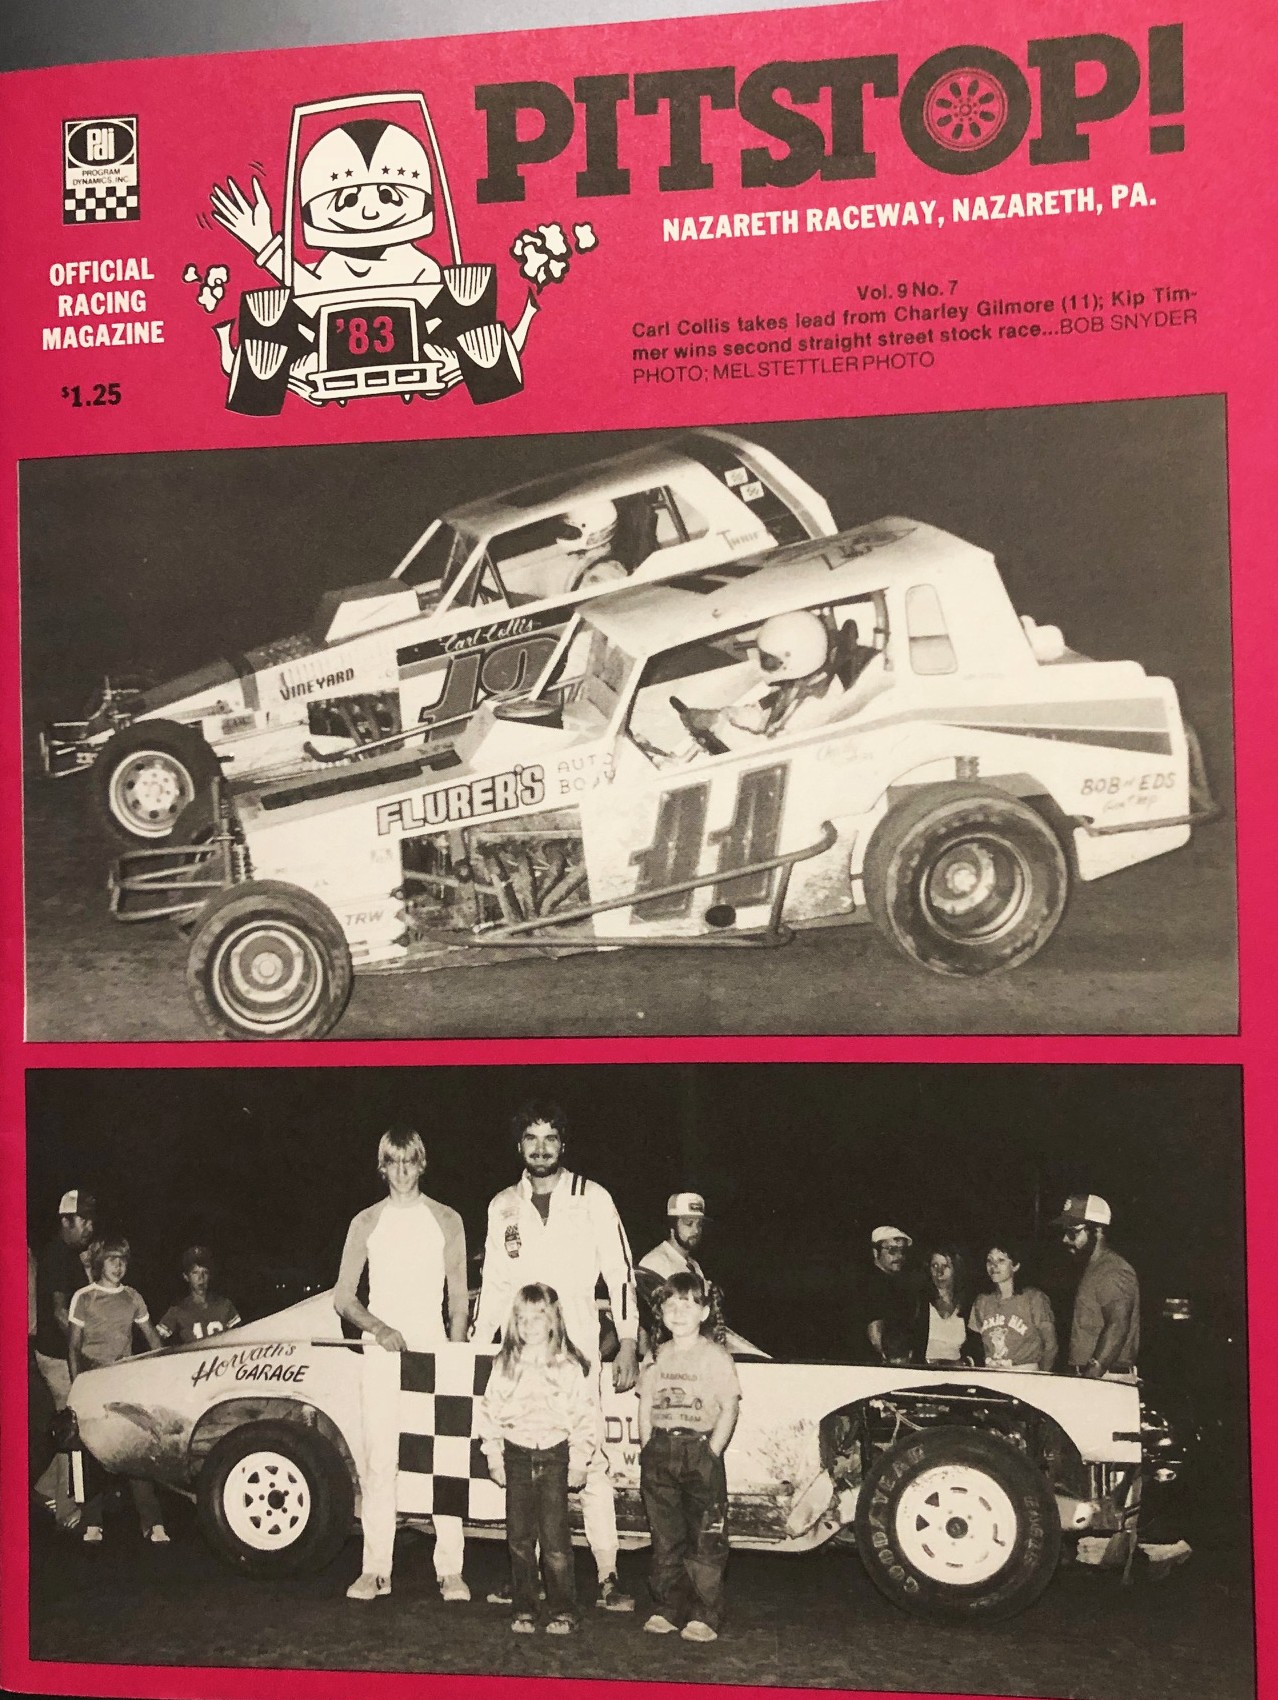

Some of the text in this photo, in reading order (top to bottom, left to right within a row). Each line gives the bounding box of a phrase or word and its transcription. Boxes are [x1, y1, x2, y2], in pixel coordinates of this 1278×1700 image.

[474, 23, 1186, 204] PITSTOP!
[82, 168, 121, 177] PROGRAM
[662, 182, 1157, 242] NAZARETH RACEWAY, NAZARETH, PA.
[49, 257, 155, 286] OFFICIAL
[58, 290, 146, 317] RACING
[856, 280, 959, 301] Vol. 9 No. 7
[632, 286, 1198, 338] Carl Collis takes lead from Charley Gilmore (11); Kip Tim-
[42, 321, 165, 350] MAGAZINE
[632, 347, 668, 361] mer
[674, 342, 717, 359] wins
[723, 336, 793, 356] second
[798, 330, 872, 351] straight
[877, 326, 934, 346] street
[940, 323, 992, 343] stock
[1110, 308, 1198, 331] SNYDER
[633, 350, 935, 384] PHOTO; MEL STETTLER PHOTO
[61, 382, 122, 408] $1.25
[280, 667, 355, 701] VINEYARD
[376, 763, 546, 836] FLURER'S
[1081, 776, 1121, 796] BOB
[1138, 771, 1177, 791] EDS
[628, 758, 793, 925] 11
[345, 910, 385, 926] TRW
[191, 1342, 297, 1388] Horvath's
[235, 1364, 310, 1383] GARAGE
[868, 1444, 926, 1594] GOODYEAR
